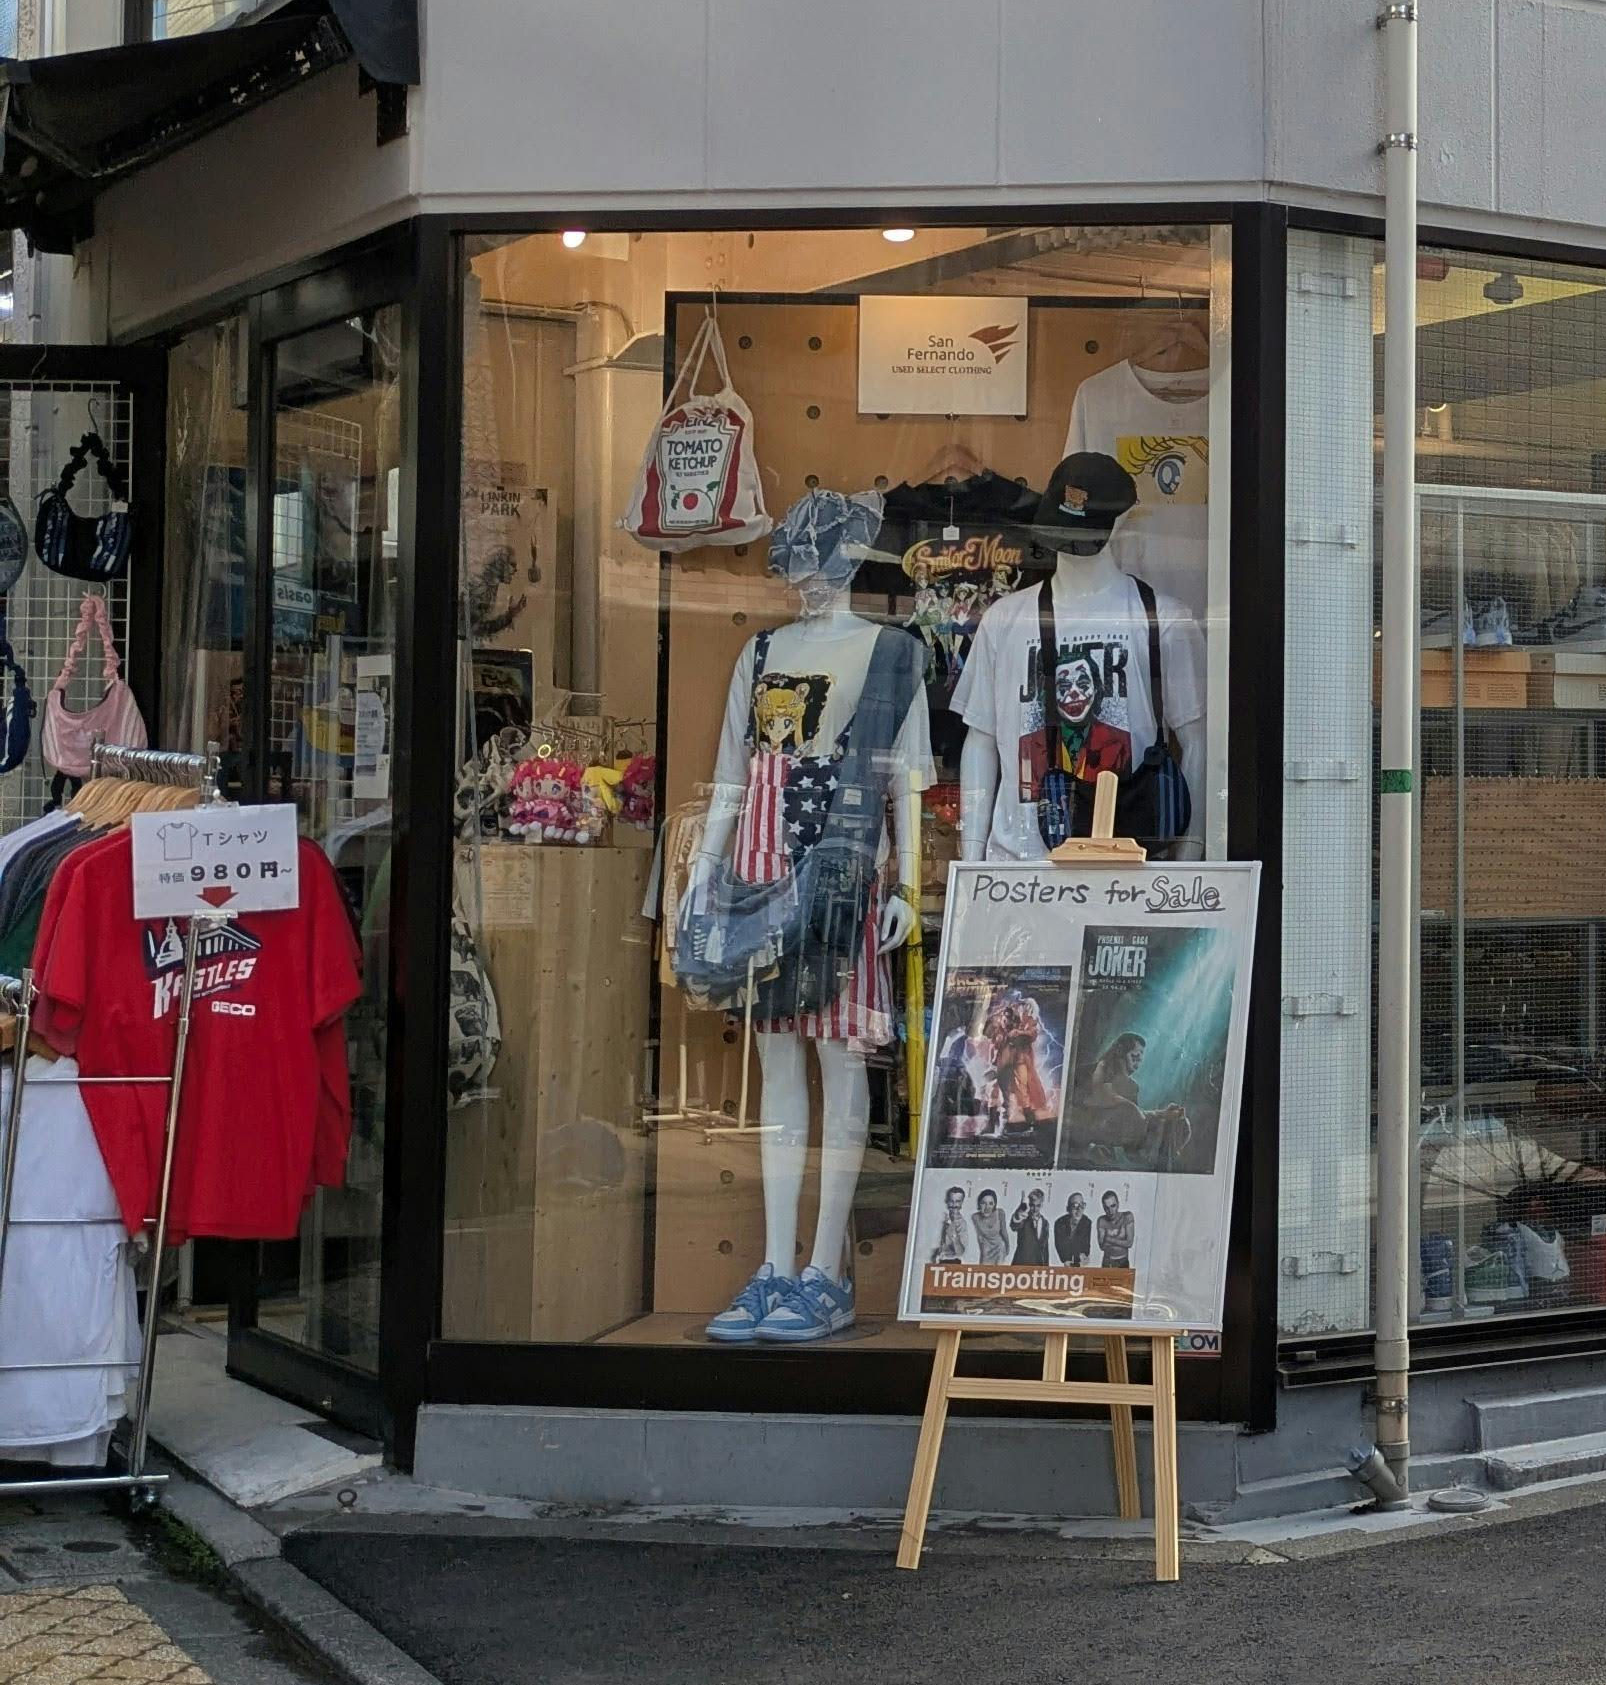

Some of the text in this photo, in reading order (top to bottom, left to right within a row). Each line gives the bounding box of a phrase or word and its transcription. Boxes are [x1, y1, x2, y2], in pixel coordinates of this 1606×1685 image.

[928, 335, 954, 348] San
[907, 348, 975, 361] Fernando
[892, 366, 992, 375] USED SELECT CLOTHING
[667, 438, 723, 455] TOMATO
[668, 455, 717, 471] KETCHUP
[480, 492, 521, 503] LINKIN
[480, 503, 521, 517] PARK
[964, 534, 1023, 571] Moon
[202, 830, 268, 847] Tシャツ
[972, 874, 1222, 912] Posters for Sale
[1088, 945, 1147, 977] JOKER
[930, 1266, 1085, 1295] Trainspotting
